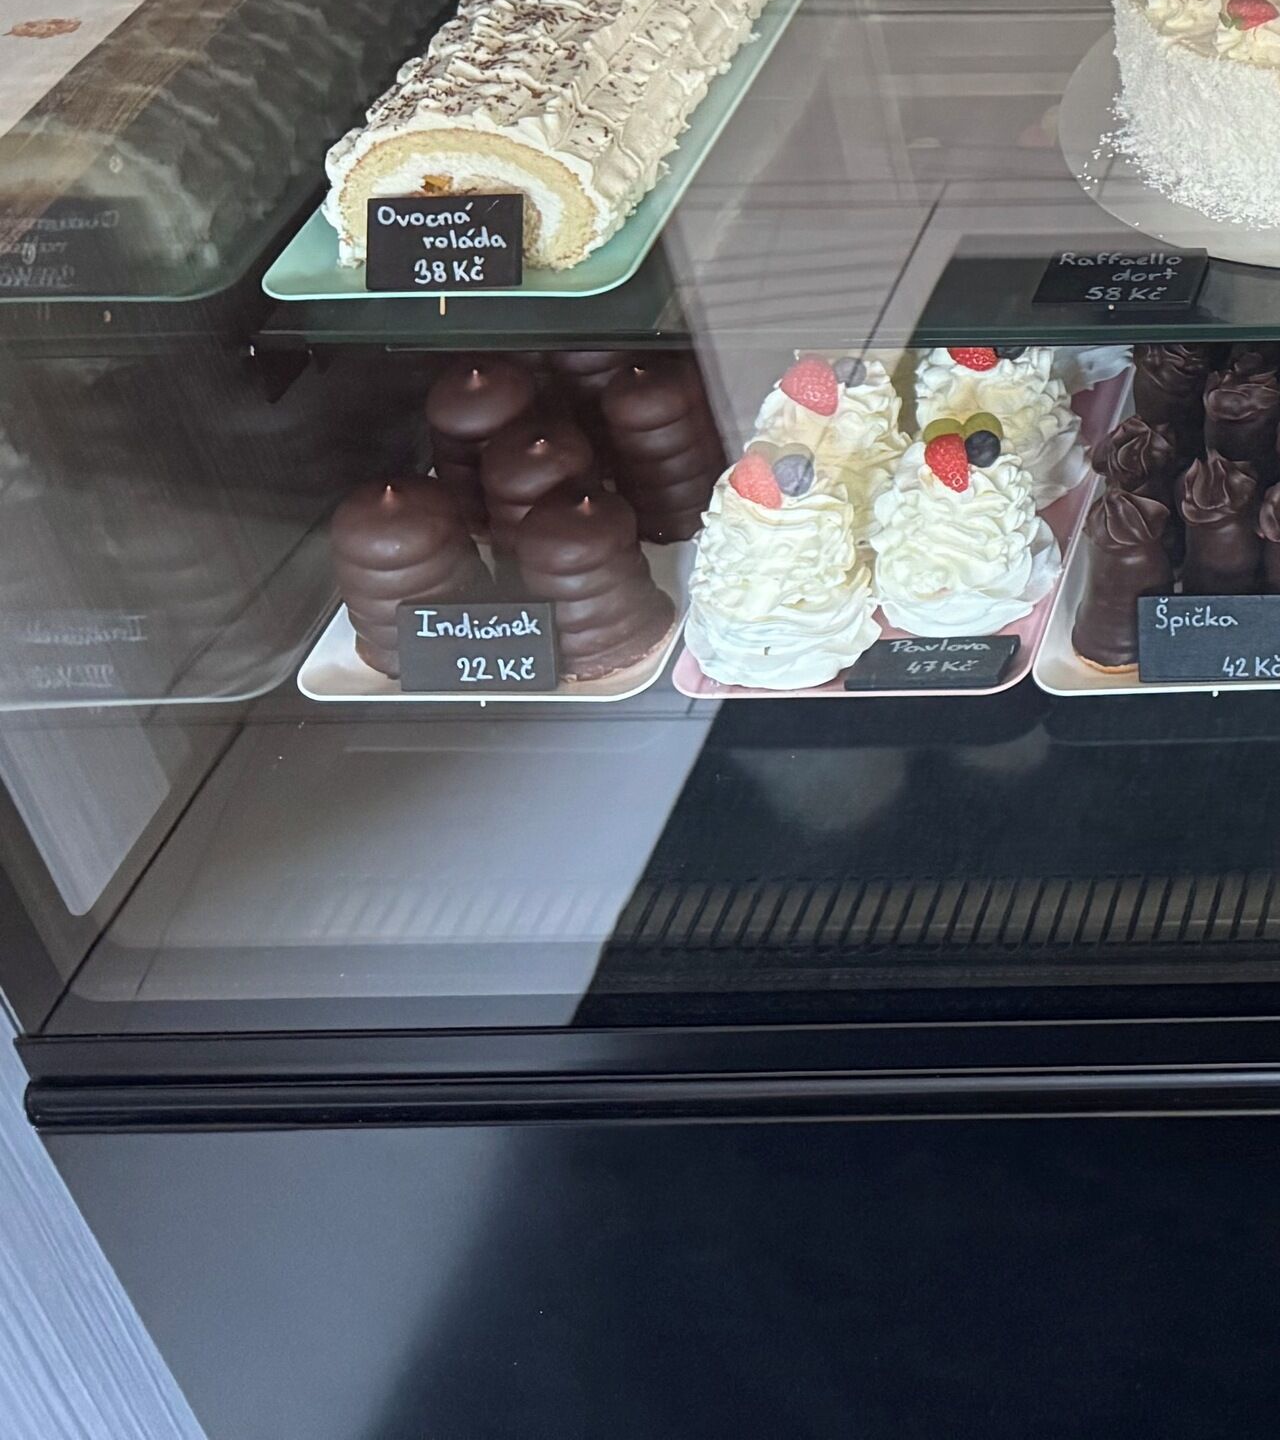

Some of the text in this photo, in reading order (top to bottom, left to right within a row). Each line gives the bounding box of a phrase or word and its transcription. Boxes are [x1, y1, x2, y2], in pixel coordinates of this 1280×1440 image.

[377, 201, 474, 228] Ovocná
[422, 225, 508, 251] roláda
[413, 255, 485, 285] 38 Kč
[1058, 251, 1184, 267] Raffaello
[1111, 267, 1178, 283] dort
[1084, 286, 1168, 301] 58 Kč
[413, 609, 542, 640] Indiánek
[1155, 596, 1239, 637] Špička
[456, 656, 536, 683] 22 Kč
[906, 659, 980, 675] 47 Kč
[1222, 655, 1250, 679] 42
